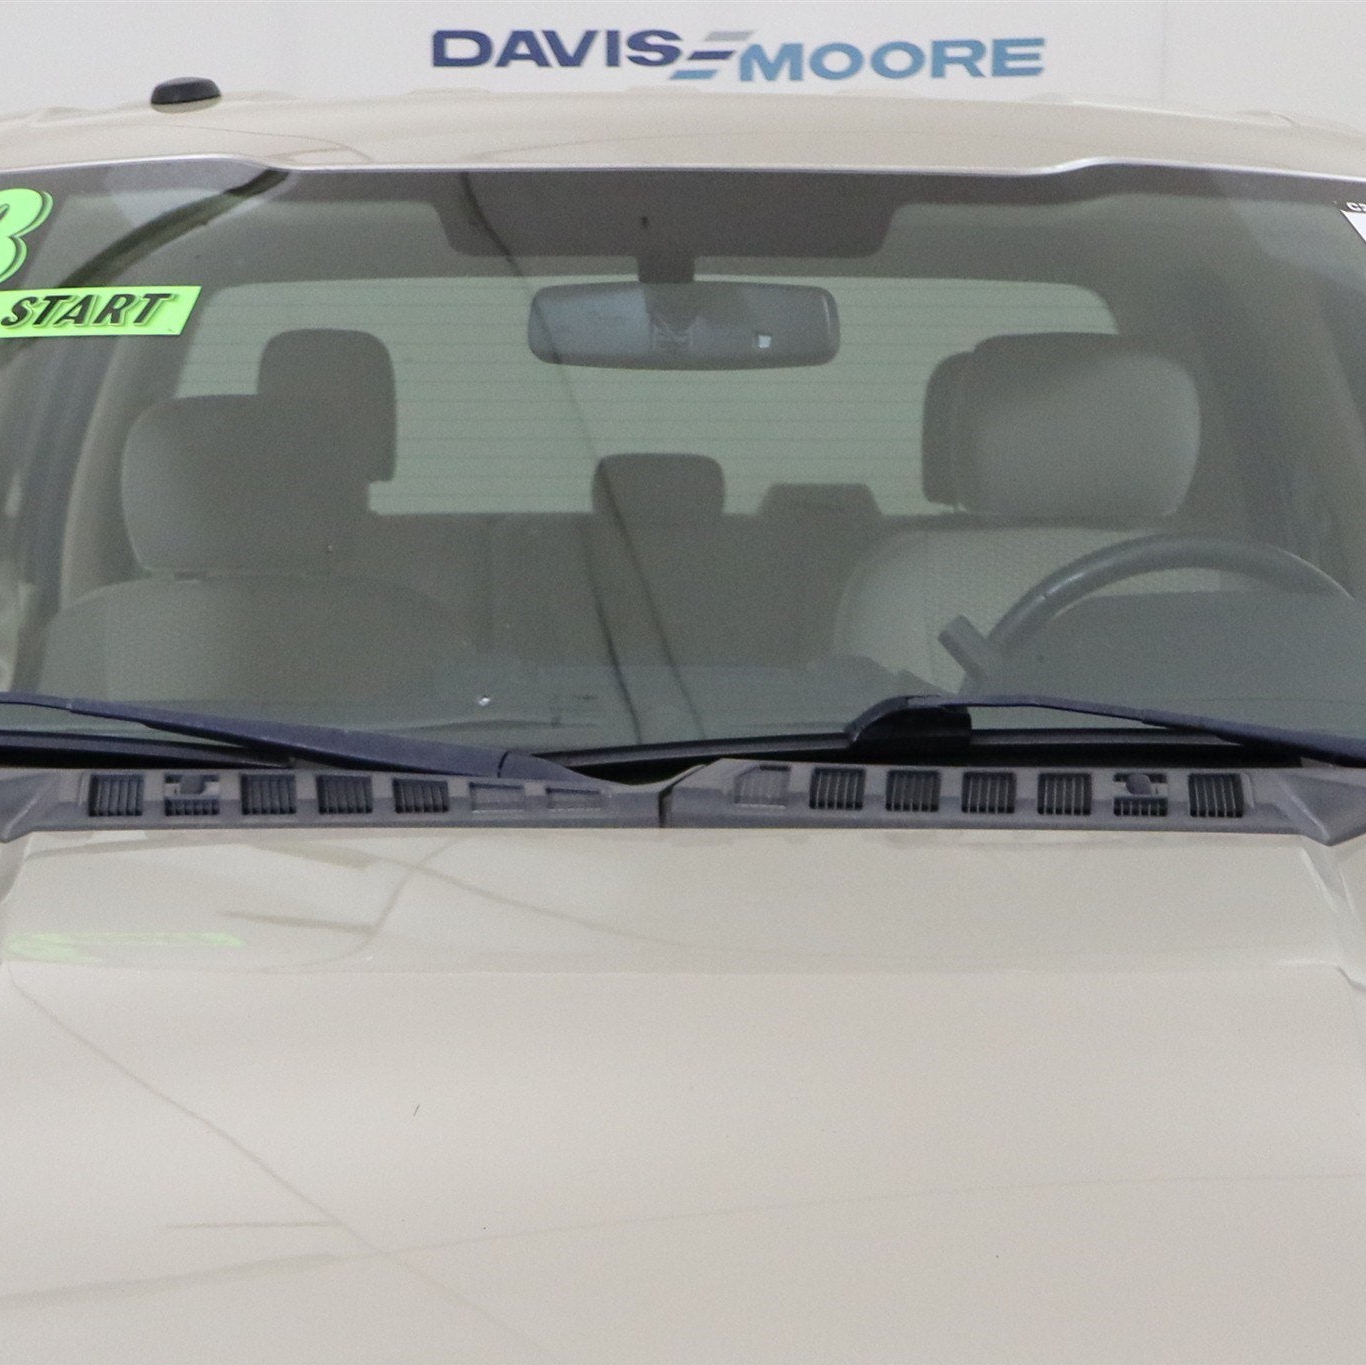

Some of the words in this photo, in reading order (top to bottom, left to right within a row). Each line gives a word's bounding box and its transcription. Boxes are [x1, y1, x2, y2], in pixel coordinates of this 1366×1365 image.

[432, 29, 683, 68] DAVIS
[739, 38, 1046, 82] MOORE
[0, 293, 177, 328] START
